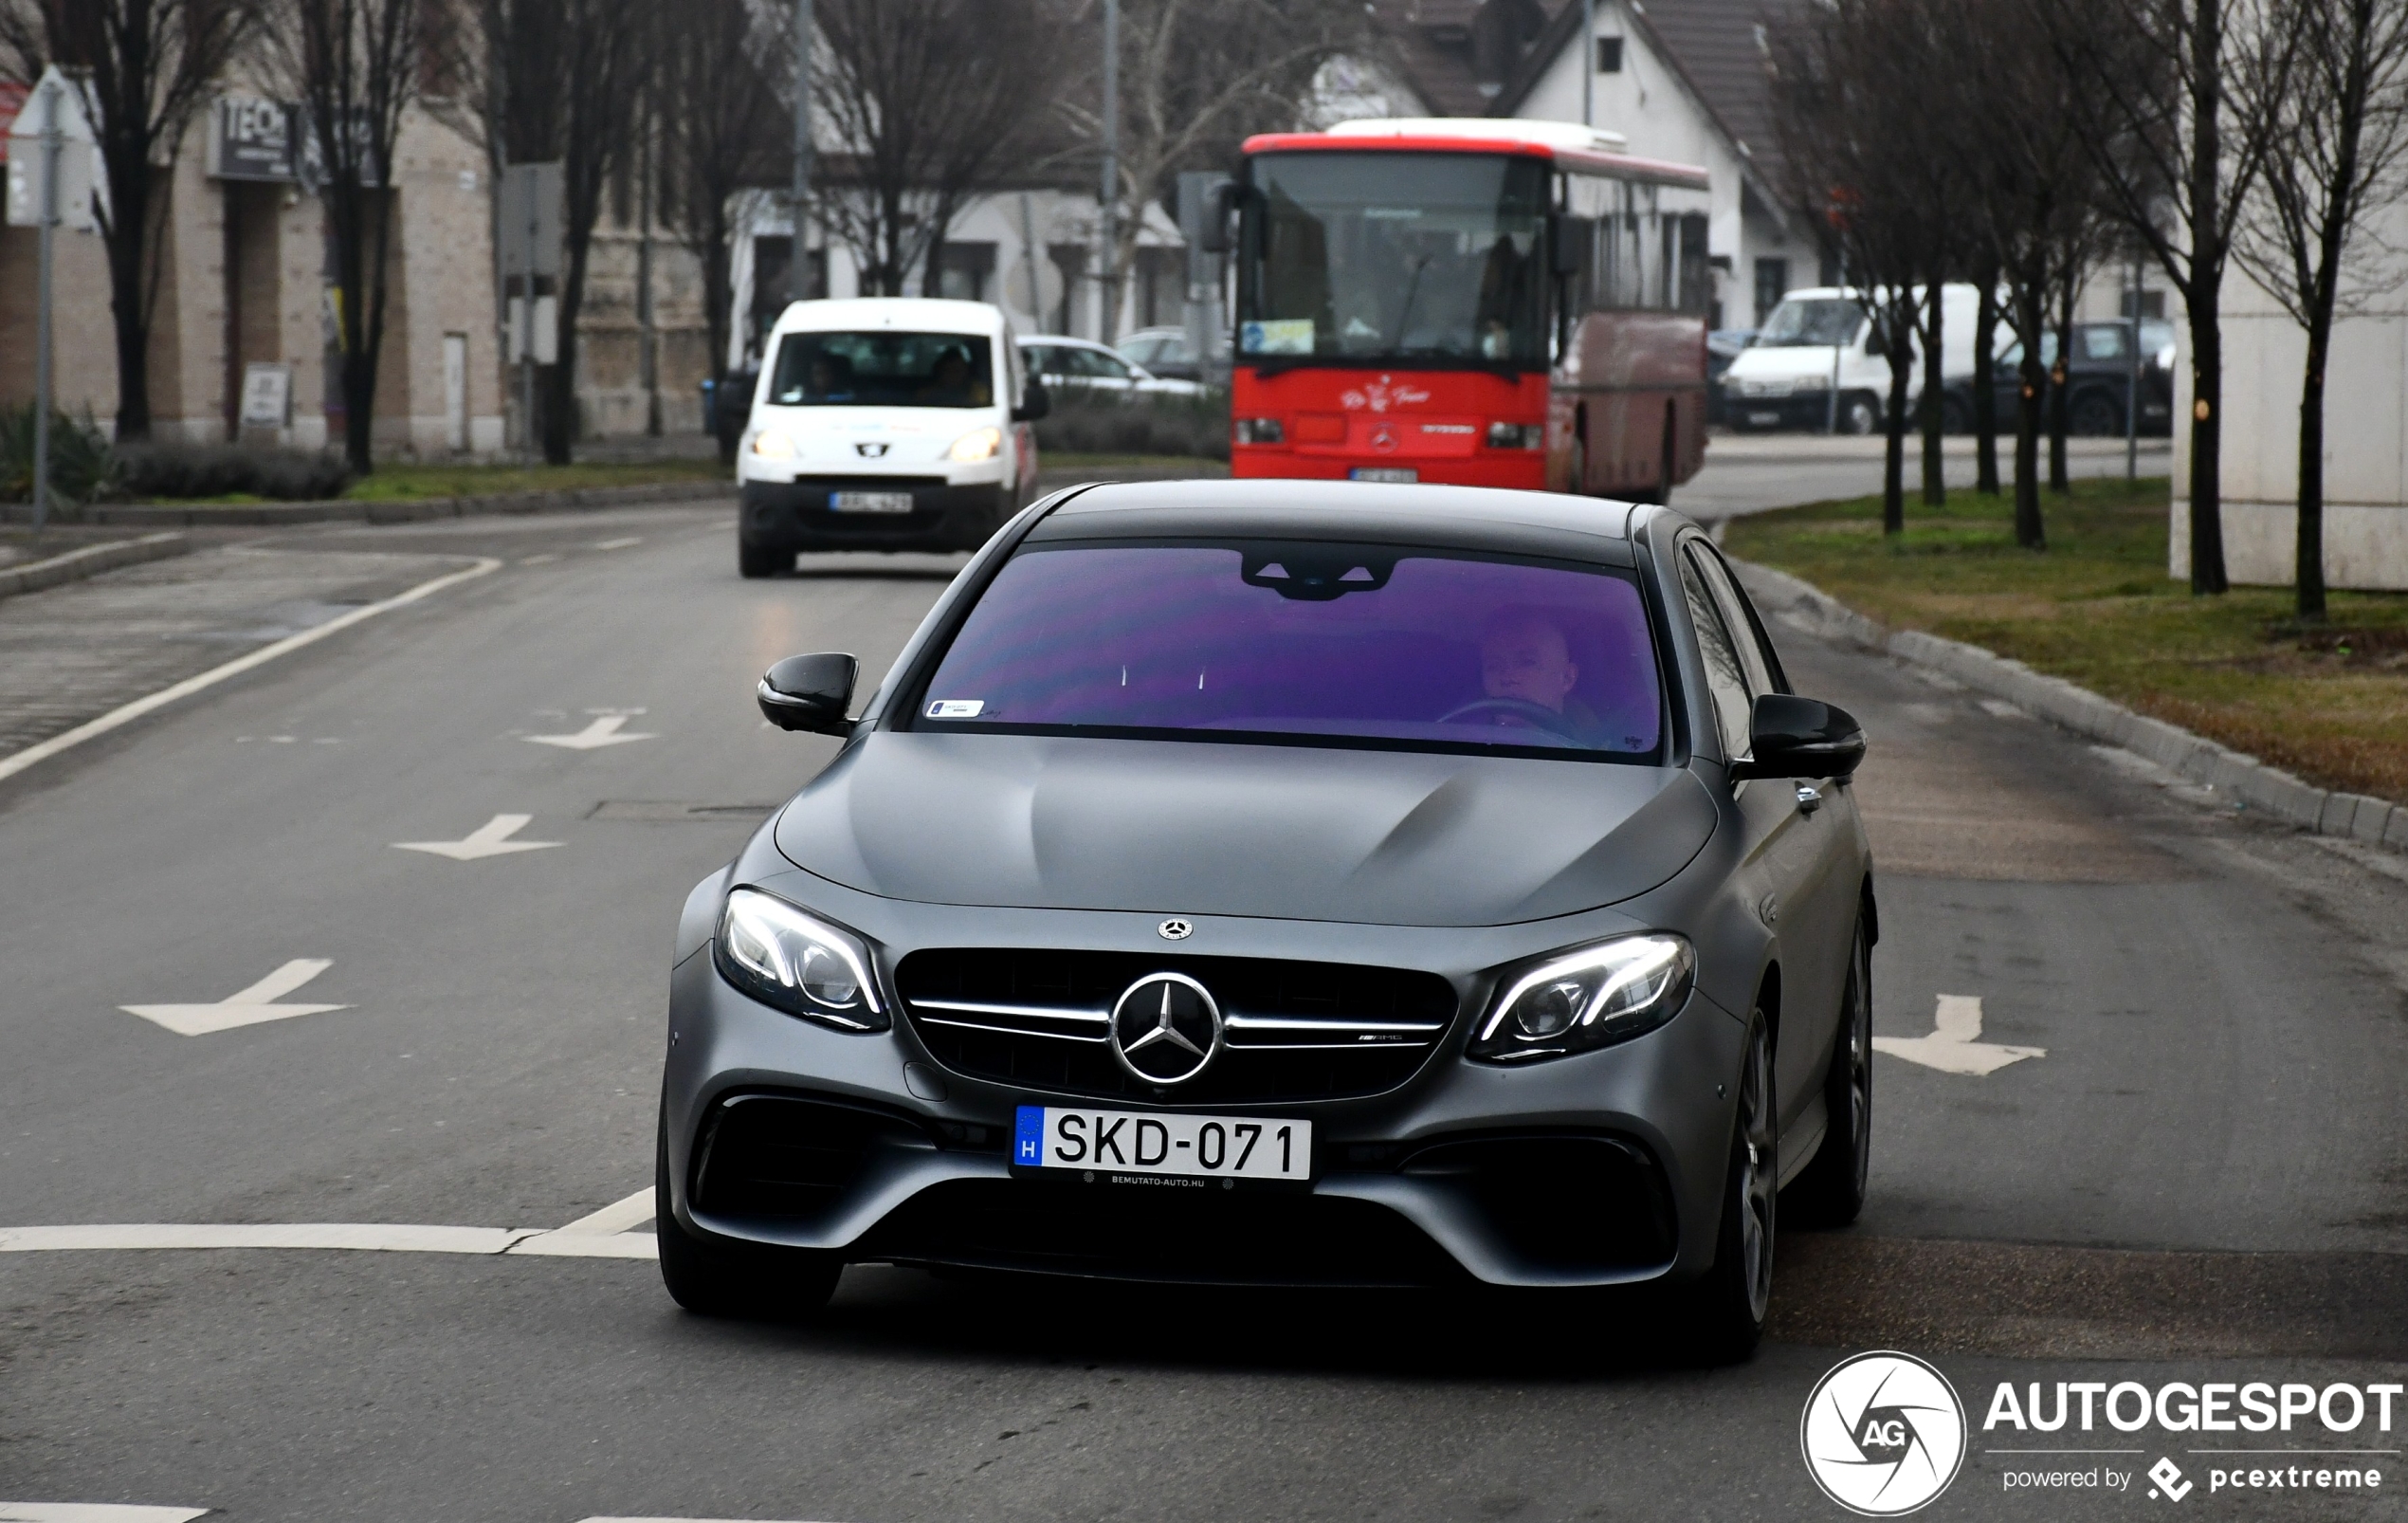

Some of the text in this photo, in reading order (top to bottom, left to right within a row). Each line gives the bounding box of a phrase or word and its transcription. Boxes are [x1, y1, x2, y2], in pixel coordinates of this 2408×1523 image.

[1021, 1141, 1035, 1158] H
[1054, 1113, 1292, 1173] SKD-071
[1112, 1175, 1205, 1187] BEMUTATO-AUTO.HU
